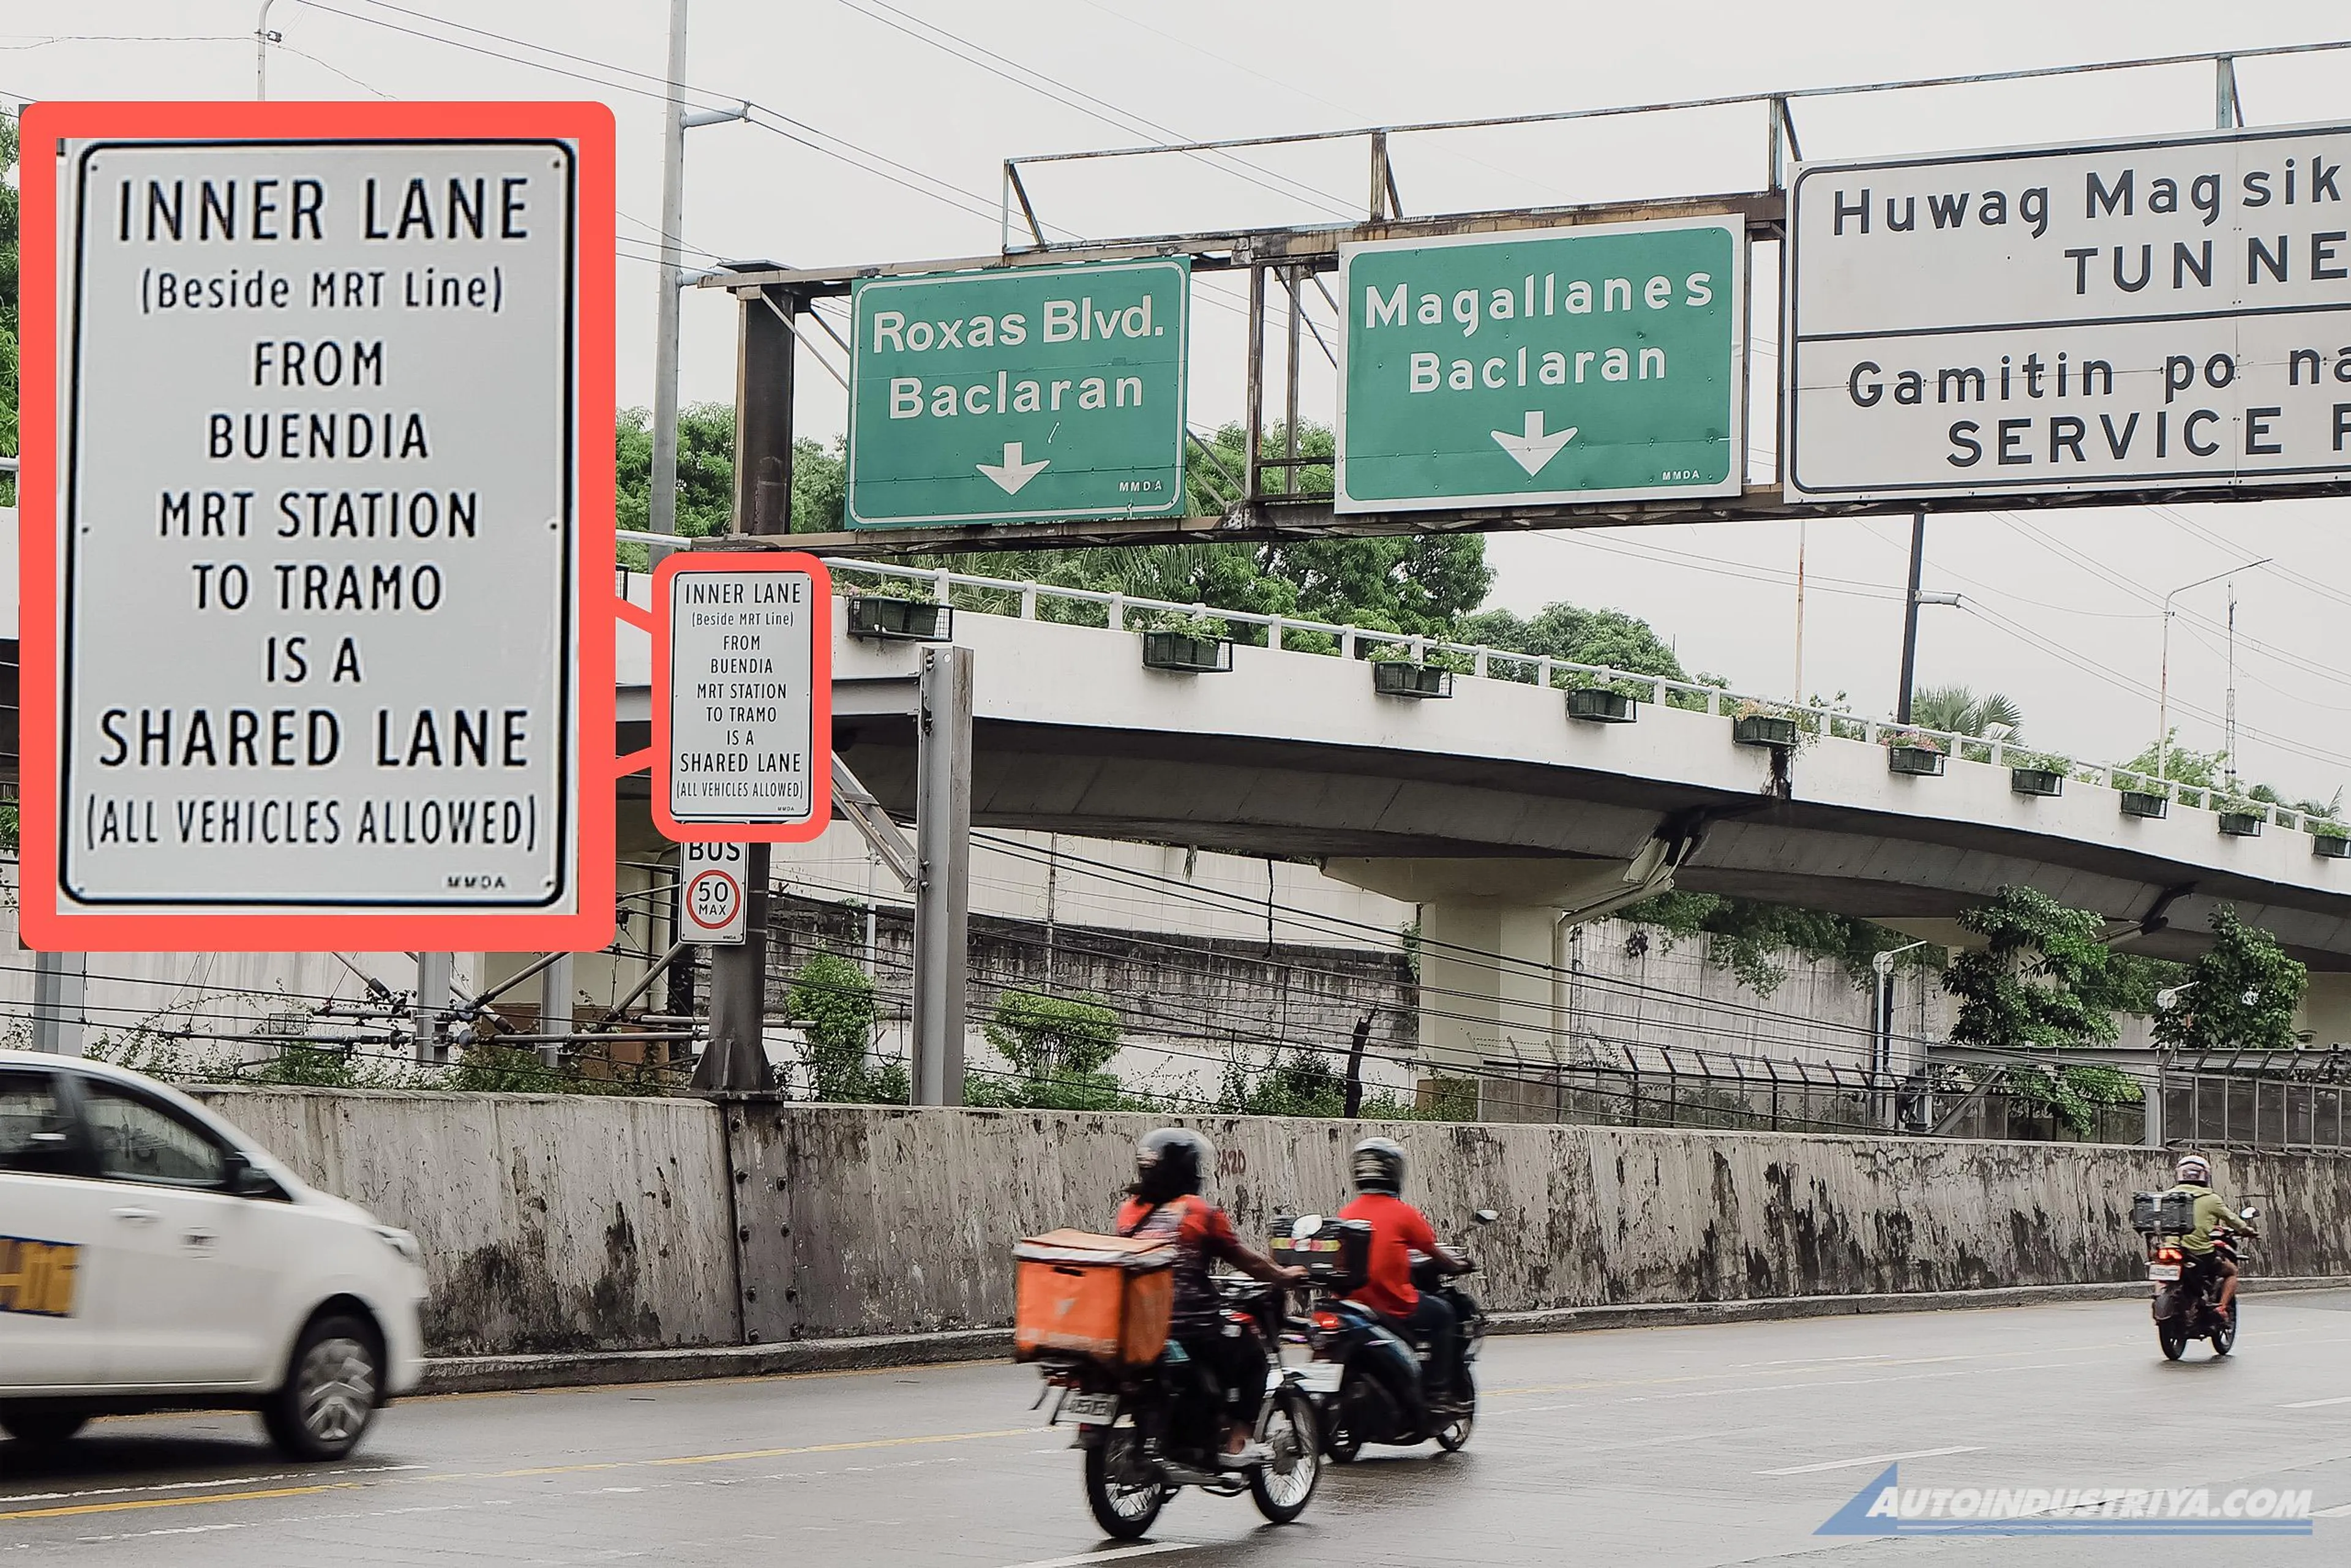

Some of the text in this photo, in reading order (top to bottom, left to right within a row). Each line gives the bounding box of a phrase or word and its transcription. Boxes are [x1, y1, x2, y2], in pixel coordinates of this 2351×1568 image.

[119, 176, 528, 241] INNER LANE
[1832, 154, 2341, 240] Huwag Magsik
[2063, 230, 2349, 295] TUNNE
[142, 265, 502, 315] (Beside MRT Line)
[1365, 271, 1714, 339] Magallanes
[872, 294, 1164, 354] Roxas Blvd.
[253, 340, 383, 388] FROM
[1408, 345, 1666, 394] Baclaran
[1848, 351, 2114, 408] Gamitin
[2165, 351, 2235, 405] po
[888, 370, 1144, 421] Baclaran
[209, 412, 429, 460] BUENDIA
[1946, 406, 2283, 468] SERVICE
[1118, 479, 1163, 493] MMDA
[1662, 469, 1700, 481] MMDA
[160, 490, 477, 539] MRT STATION
[191, 563, 442, 611] TO TRAMO
[685, 582, 801, 605] INNER LANE
[691, 610, 795, 628] (Beside MRT Line)
[723, 634, 761, 651] FROM
[266, 636, 361, 683] IS A
[710, 658, 773, 675] BUENDIA
[697, 683, 787, 700] MRT STATION
[705, 706, 777, 723] TO TRAMO
[99, 708, 528, 768] SHARED LANE
[726, 729, 755, 746] IS A
[680, 752, 801, 773] SHARED LANE
[676, 779, 803, 800] (ALL VEHICLES ALLOWED)
[86, 793, 536, 853] (ALL VEHICLES ALLOWED)
[688, 842, 741, 861] BUS
[446, 875, 507, 890] MMDA
[697, 880, 729, 903] 50
[698, 903, 727, 917] MAX
